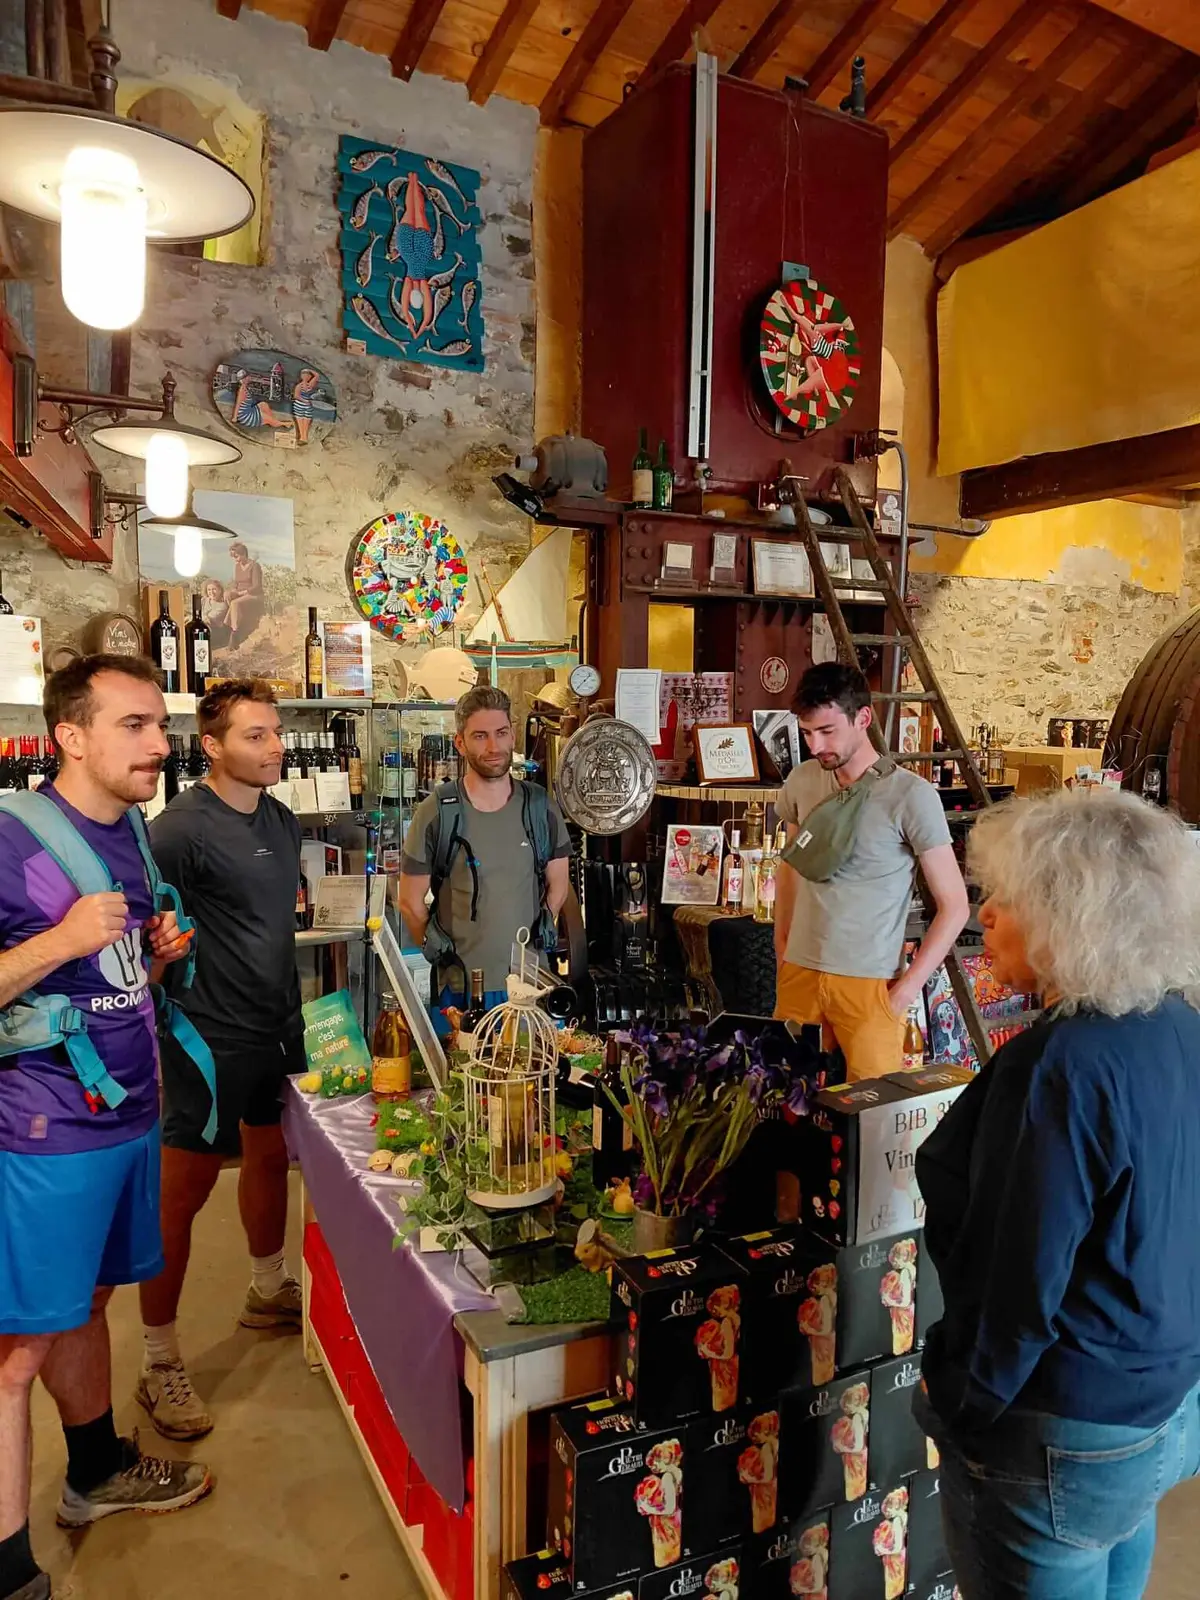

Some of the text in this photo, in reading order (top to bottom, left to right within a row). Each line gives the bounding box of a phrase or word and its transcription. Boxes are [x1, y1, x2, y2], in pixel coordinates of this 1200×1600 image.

[109, 622, 128, 638] Vins
[308, 1013, 344, 1034] m'engage,
[318, 1029, 336, 1043] c'est
[310, 1038, 349, 1062] ma nature
[894, 1106, 928, 1135] BIB
[884, 1149, 916, 1173] Vin
